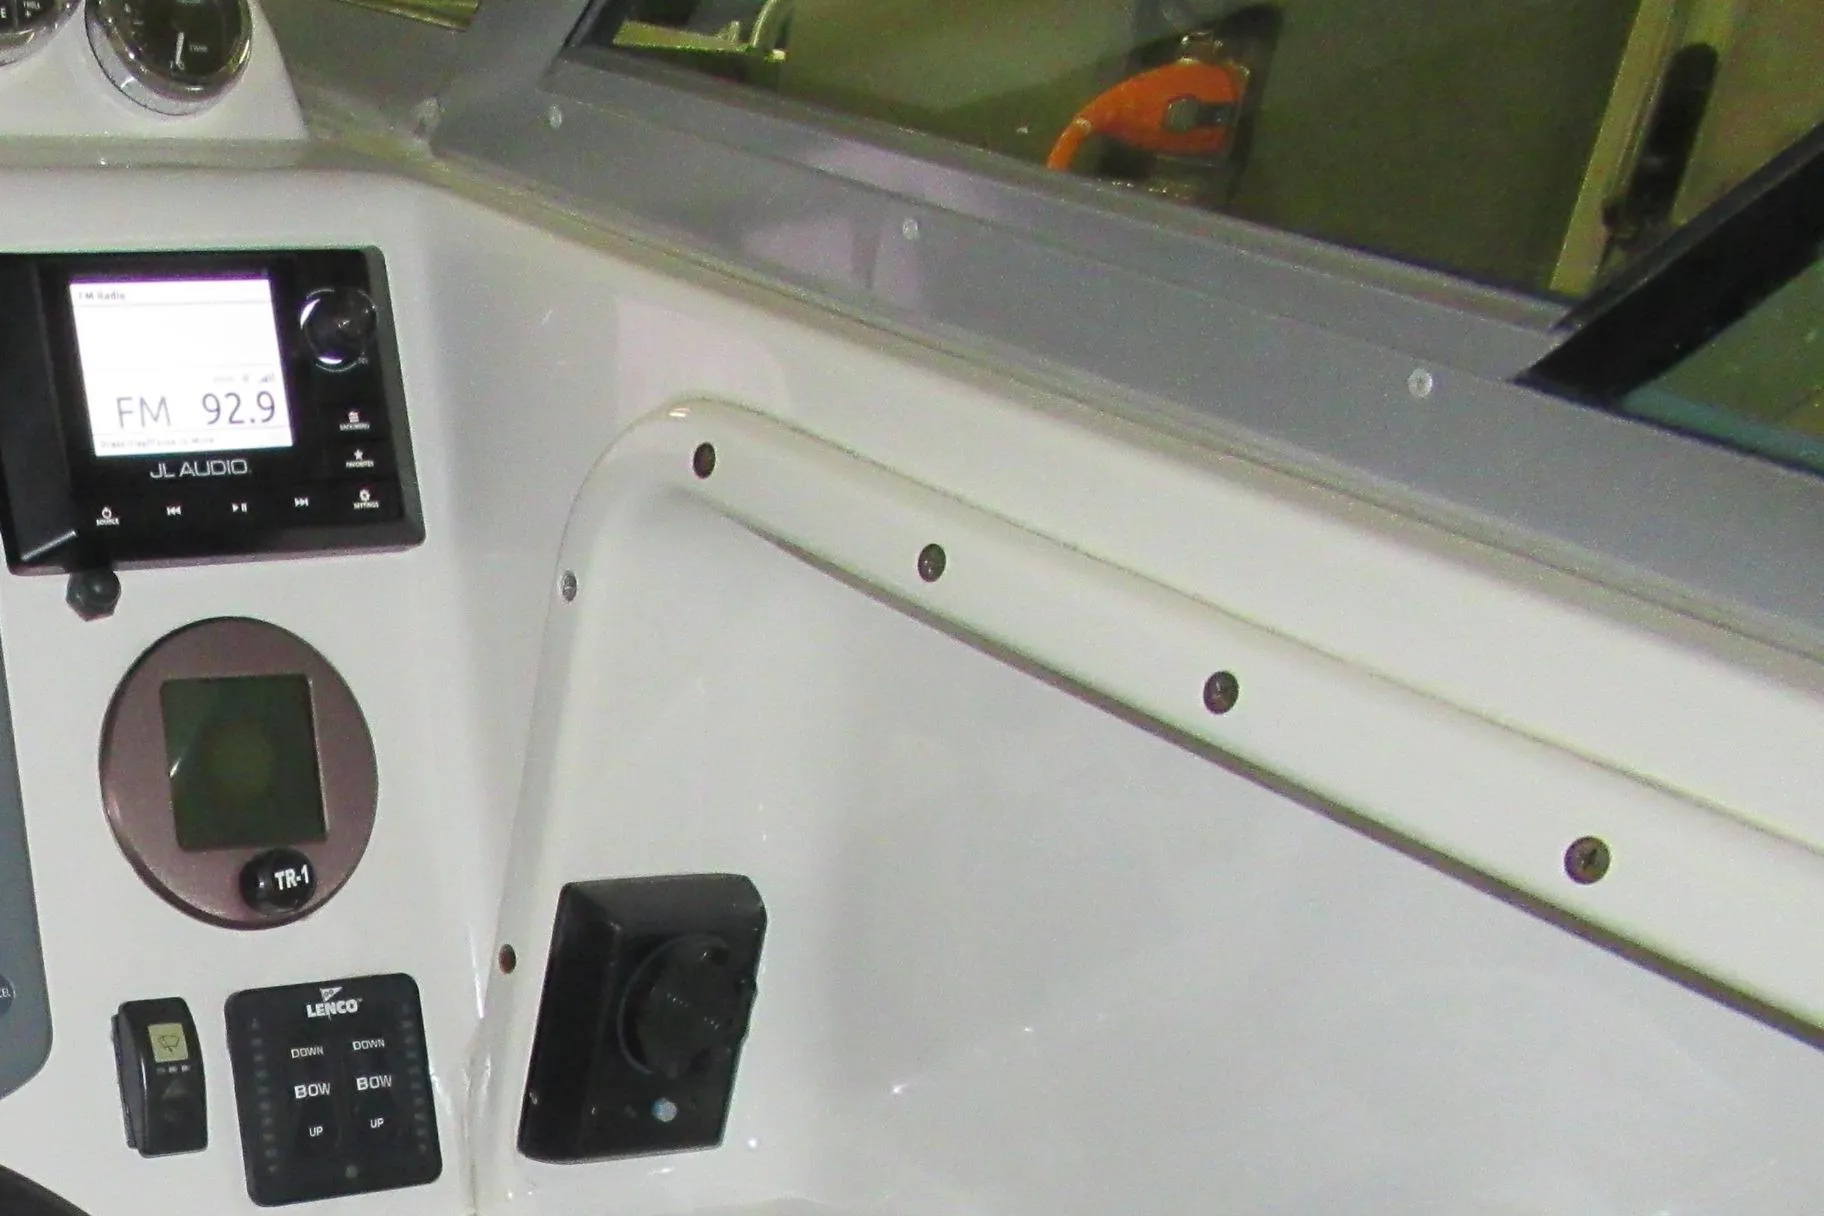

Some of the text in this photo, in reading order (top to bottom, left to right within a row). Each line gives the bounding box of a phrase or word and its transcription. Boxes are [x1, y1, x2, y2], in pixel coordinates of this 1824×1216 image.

[116, 391, 276, 428] FM 92.9
[150, 459, 248, 479] JL AUDIO
[274, 864, 310, 891] TR-1
[306, 999, 358, 1019] LENCO
[290, 1045, 324, 1059] DOWN
[352, 1037, 385, 1051] DOWN
[309, 1125, 323, 1138] UP
[370, 1117, 384, 1130] UP
